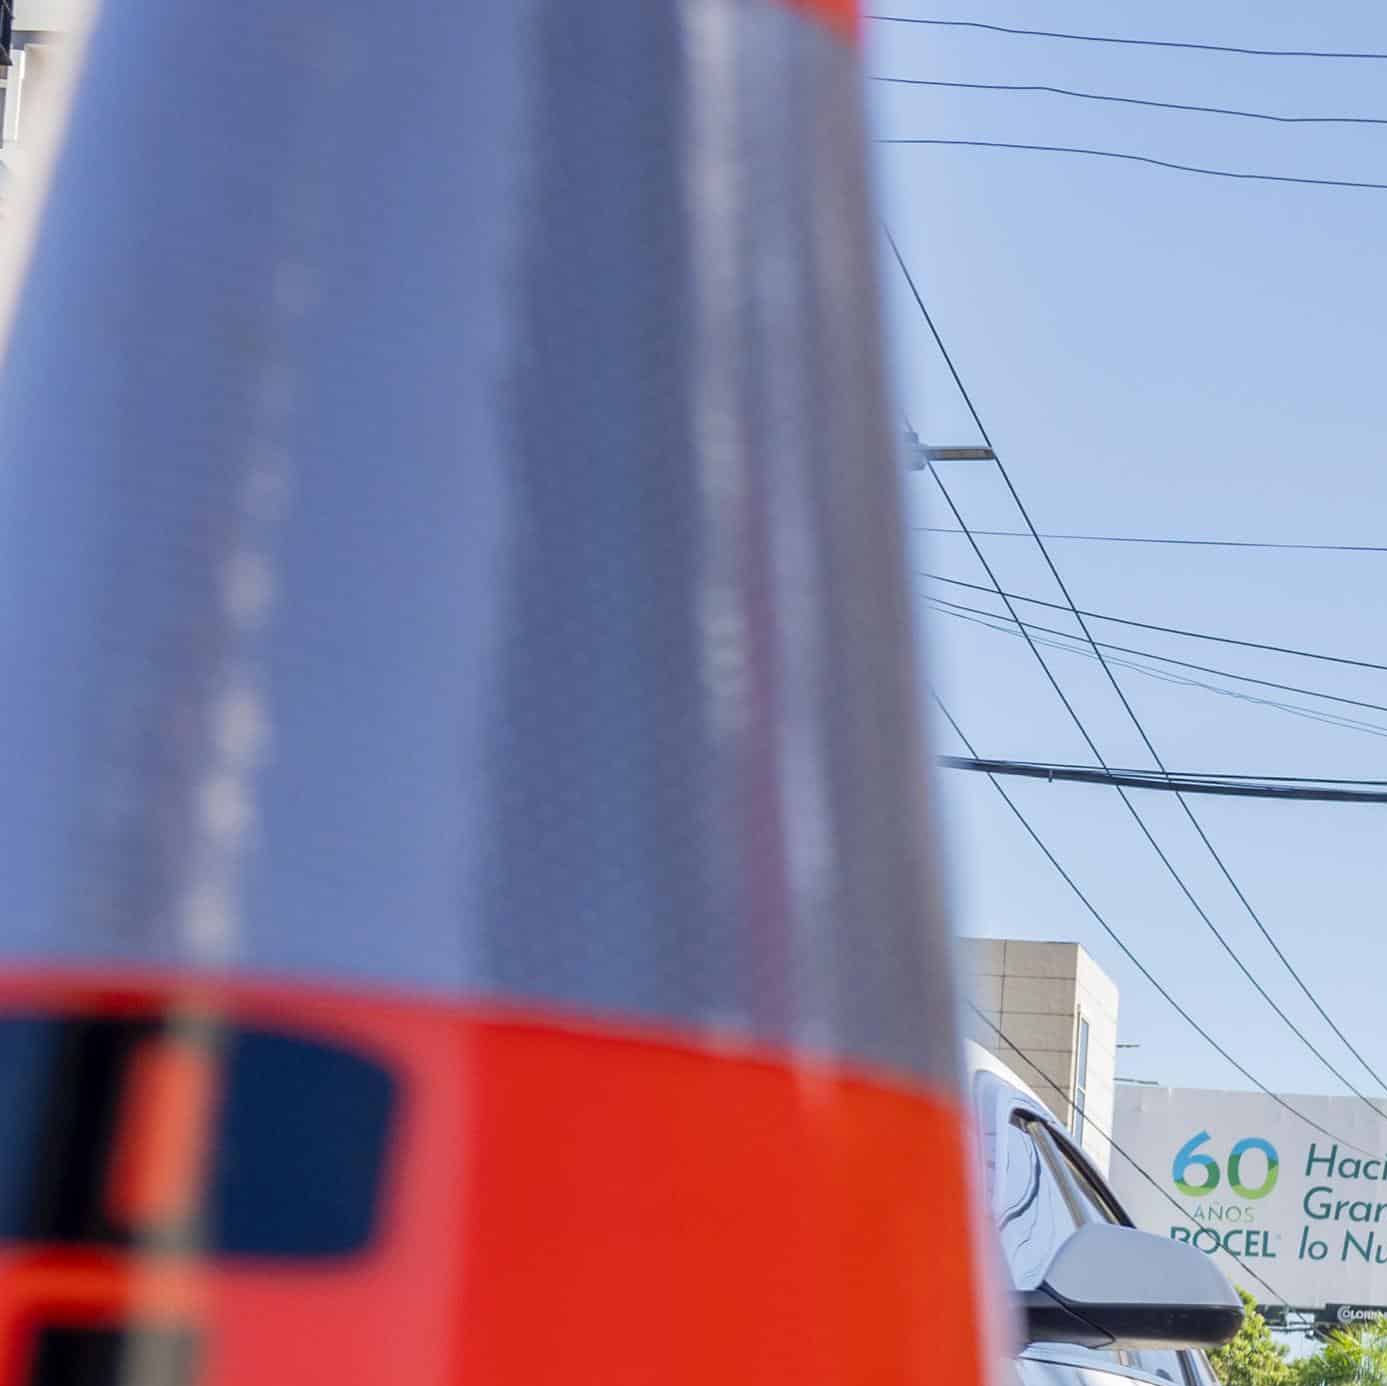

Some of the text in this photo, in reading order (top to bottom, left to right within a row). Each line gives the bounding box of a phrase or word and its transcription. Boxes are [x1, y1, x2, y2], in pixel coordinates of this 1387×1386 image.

[1172, 1130, 1280, 1200] 60
[1192, 1200, 1256, 1223] AÑOS
[1298, 1224, 1329, 1261] lo
